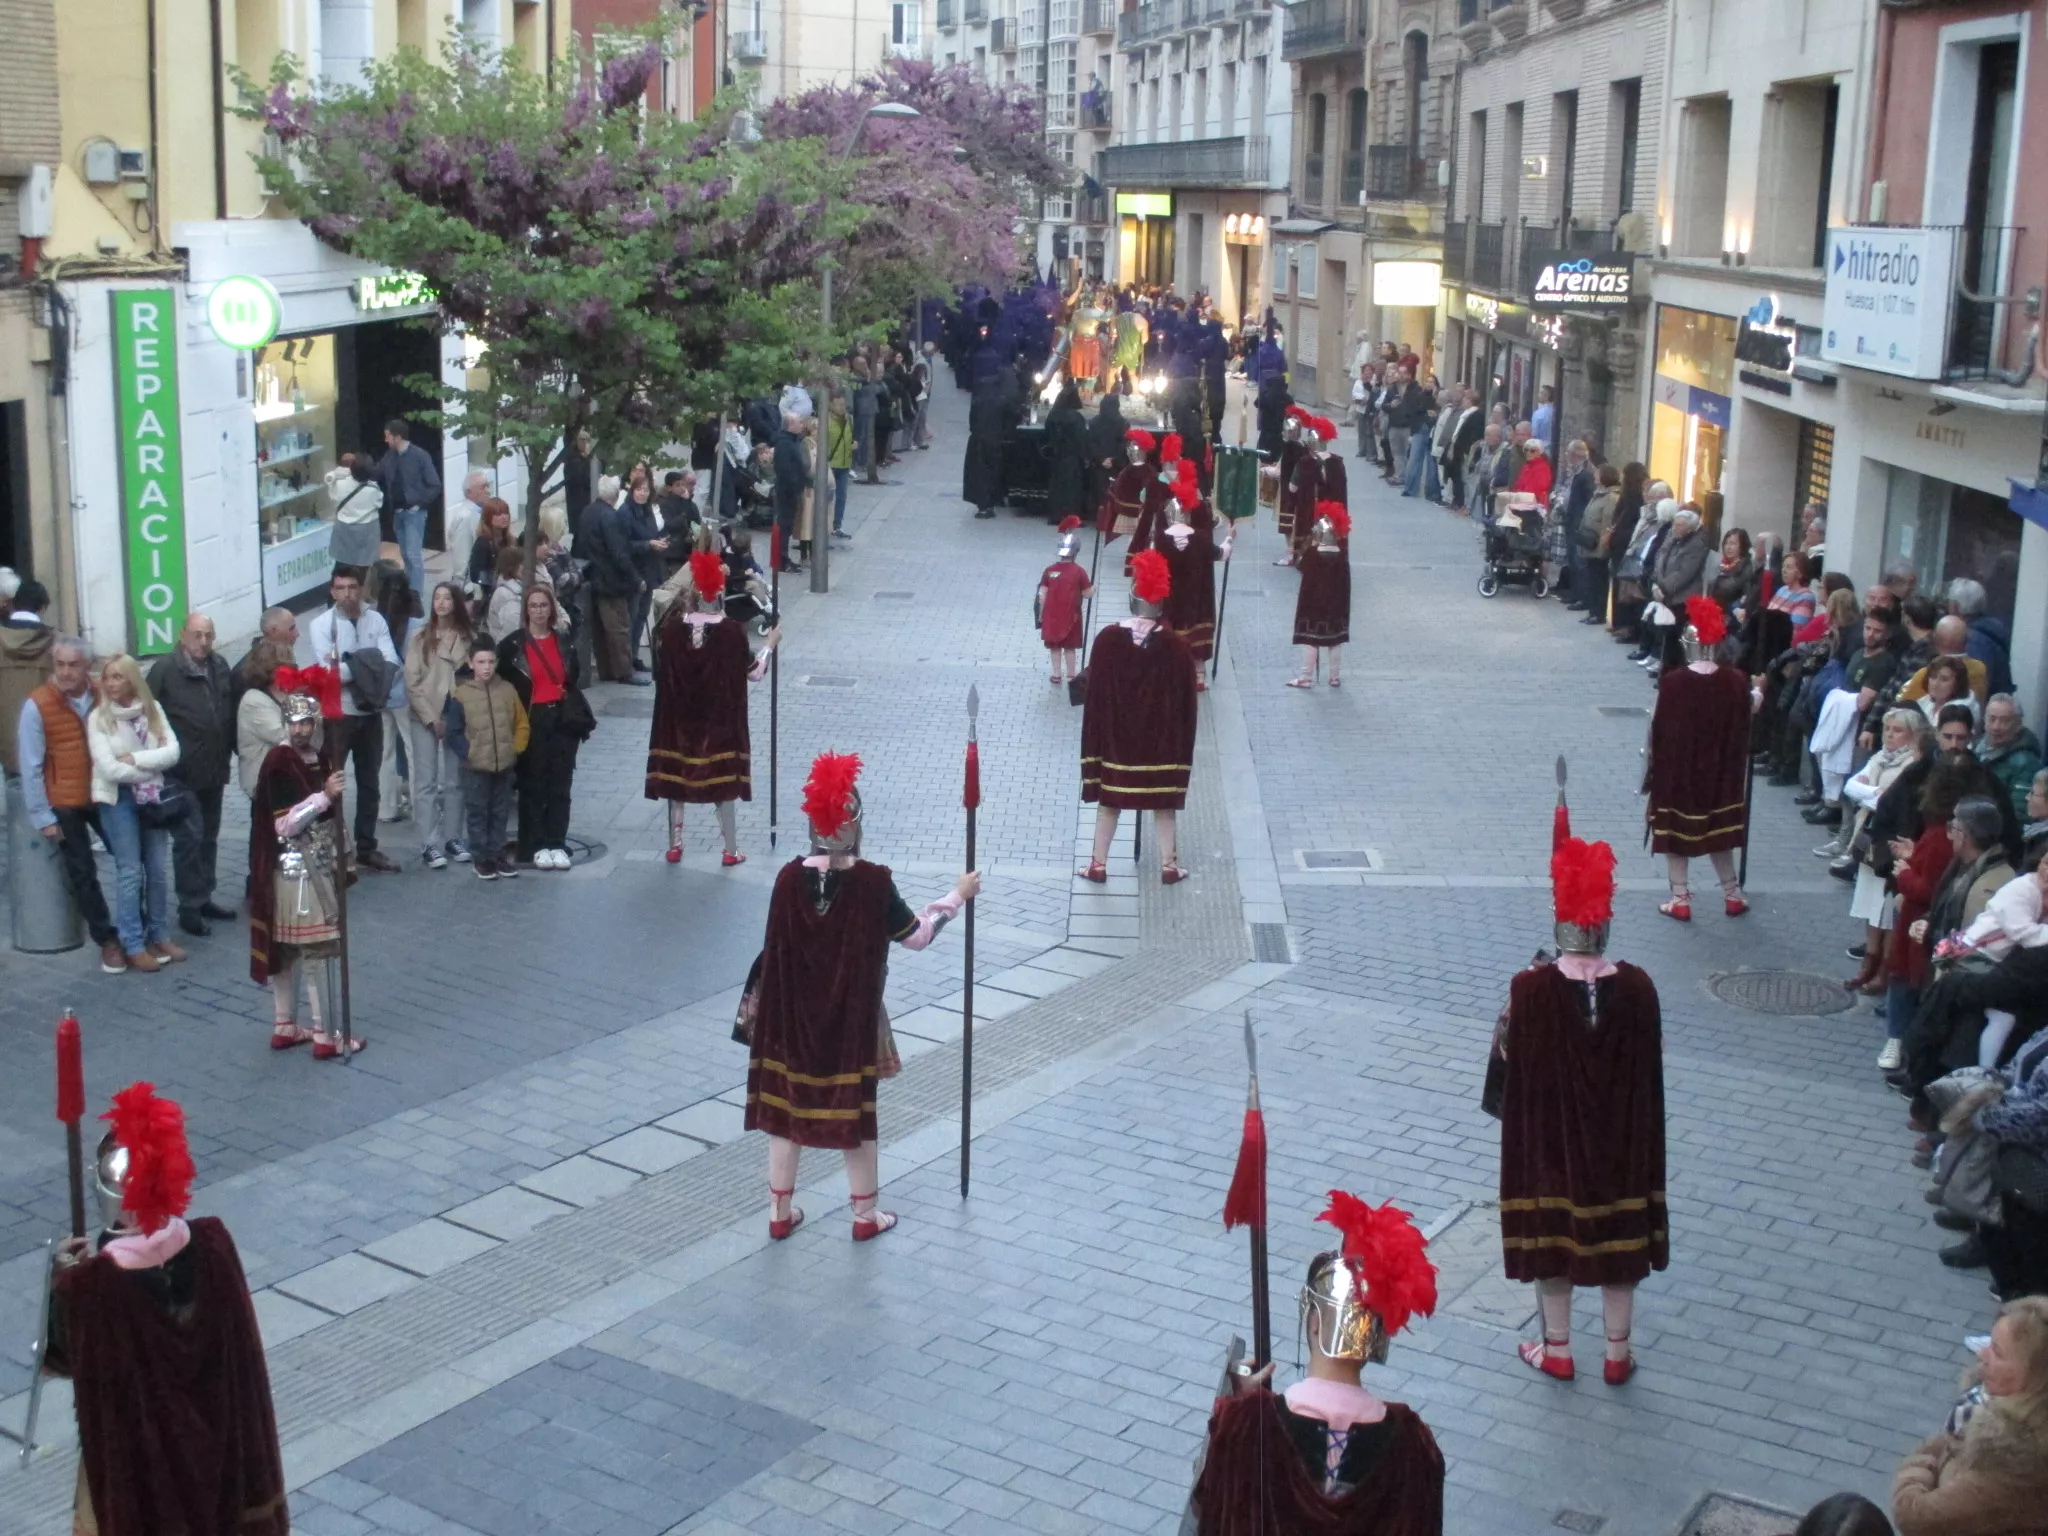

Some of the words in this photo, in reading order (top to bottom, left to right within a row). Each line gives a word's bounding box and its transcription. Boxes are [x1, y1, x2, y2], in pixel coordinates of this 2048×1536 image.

[1847, 240, 1919, 286] hitradio
[1535, 266, 1630, 293] Arenas
[1535, 293, 1563, 302] CENTRO
[1563, 292, 1589, 302] ÓPTICO
[1590, 294, 1596, 302] Y
[1597, 294, 1628, 303] AUDITIVO
[1845, 290, 1875, 311] Huesca
[131, 302, 174, 646] REPARACION
